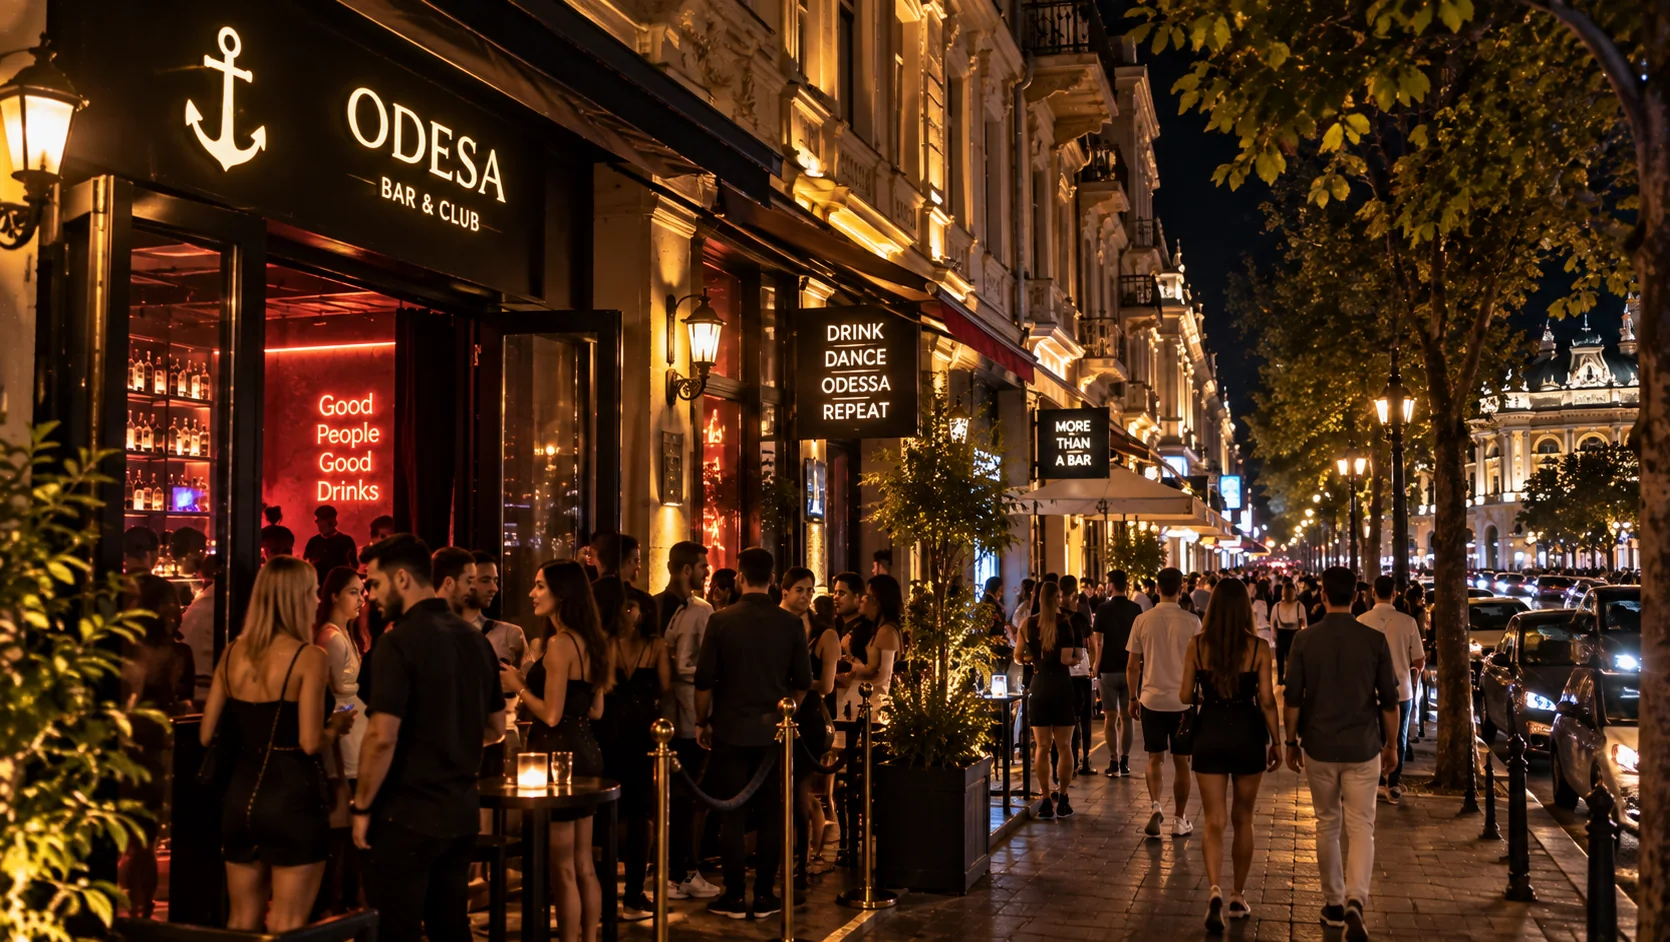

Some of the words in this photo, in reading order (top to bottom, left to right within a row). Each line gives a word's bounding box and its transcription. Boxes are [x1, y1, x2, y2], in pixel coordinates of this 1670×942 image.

[347, 87, 507, 204] ODESA
[381, 176, 417, 210] BAR
[421, 193, 435, 216] &
[439, 200, 481, 233] CLUB
[827, 322, 885, 342] DRINK
[824, 348, 887, 368] DANCE
[821, 374, 892, 394] ODESSA
[318, 392, 374, 417] Good
[823, 401, 890, 421] REPEAT
[317, 422, 381, 449] People
[1055, 419, 1091, 433] MORE
[1055, 436, 1091, 450] THAN
[318, 450, 372, 473] Good
[1055, 454, 1065, 467] A
[1067, 453, 1092, 467] BAR
[316, 479, 381, 502] Drinks
